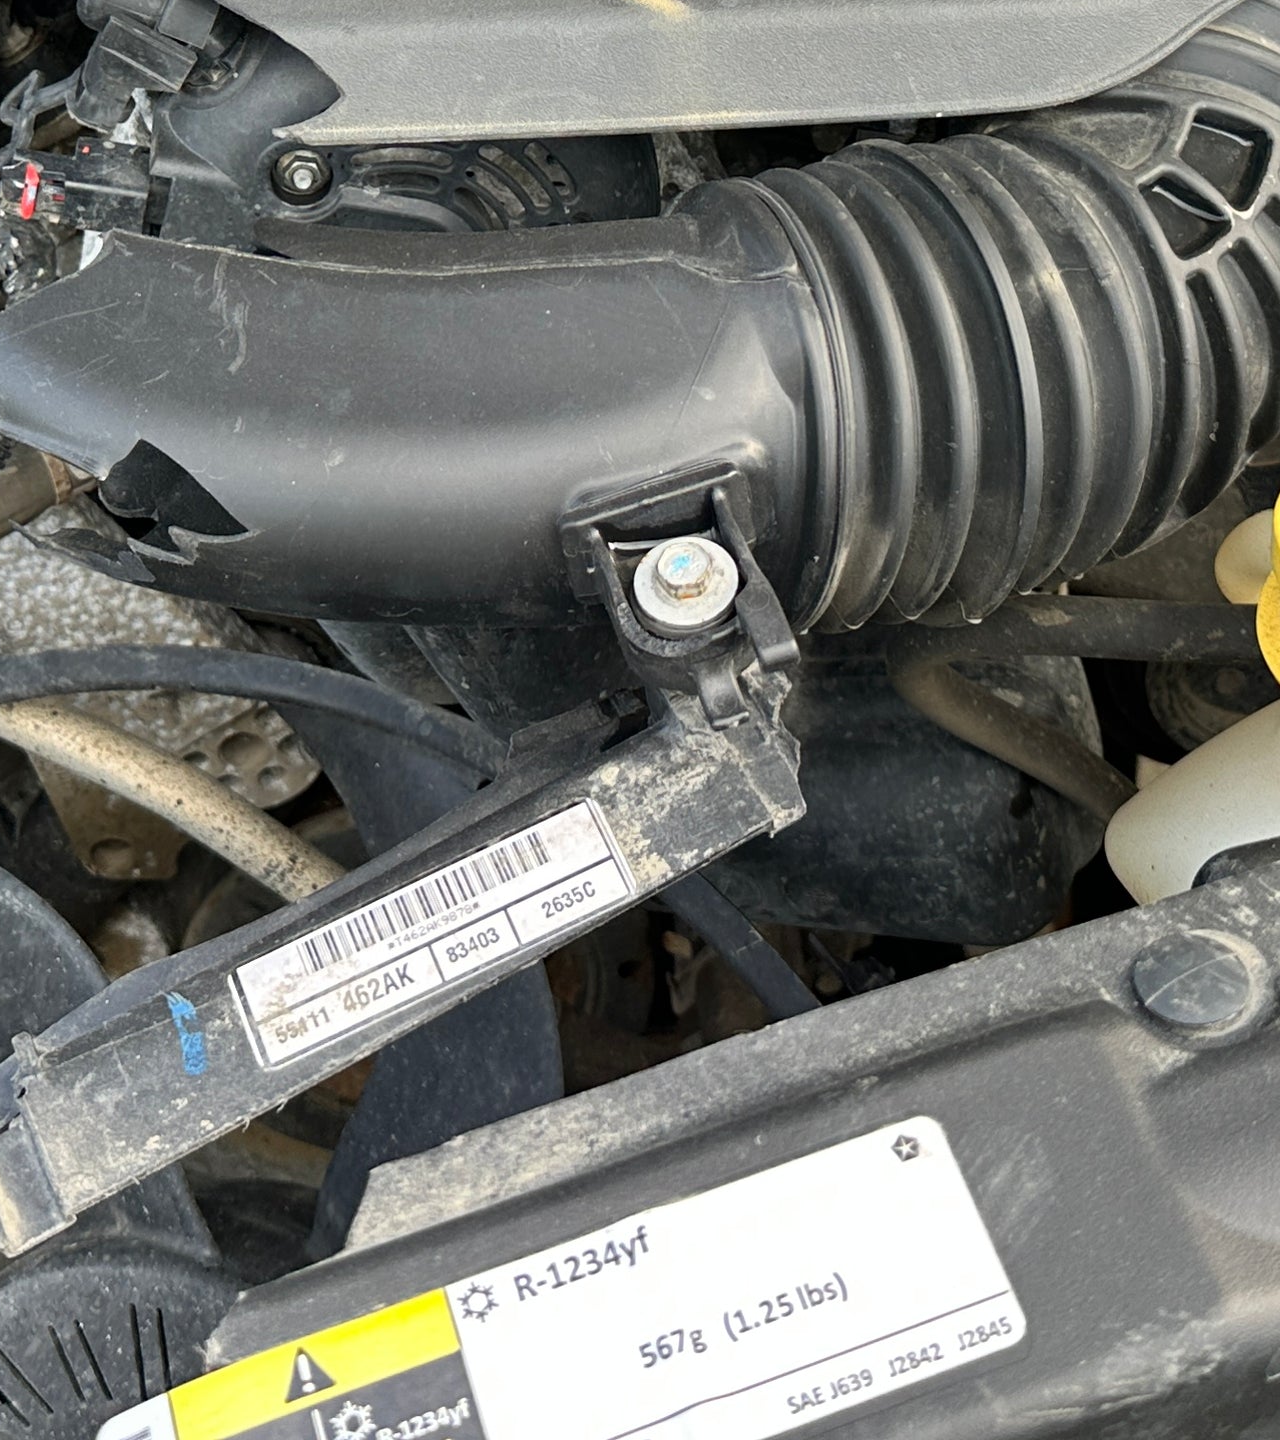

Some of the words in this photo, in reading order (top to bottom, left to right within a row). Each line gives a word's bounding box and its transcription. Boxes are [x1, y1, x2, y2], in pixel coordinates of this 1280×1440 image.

[541, 880, 597, 920] 2635C
[445, 927, 501, 964] 83403
[344, 962, 415, 1012] 462AK
[513, 1225, 650, 1302] R-1234yf
[638, 1328, 708, 1369] 567g
[722, 1293, 795, 1343] (1.25
[795, 1272, 849, 1311] lbs)
[786, 1388, 826, 1415] SAE
[831, 1369, 875, 1399] J639
[888, 1343, 945, 1378] J2842
[958, 1316, 1013, 1352] J2845
